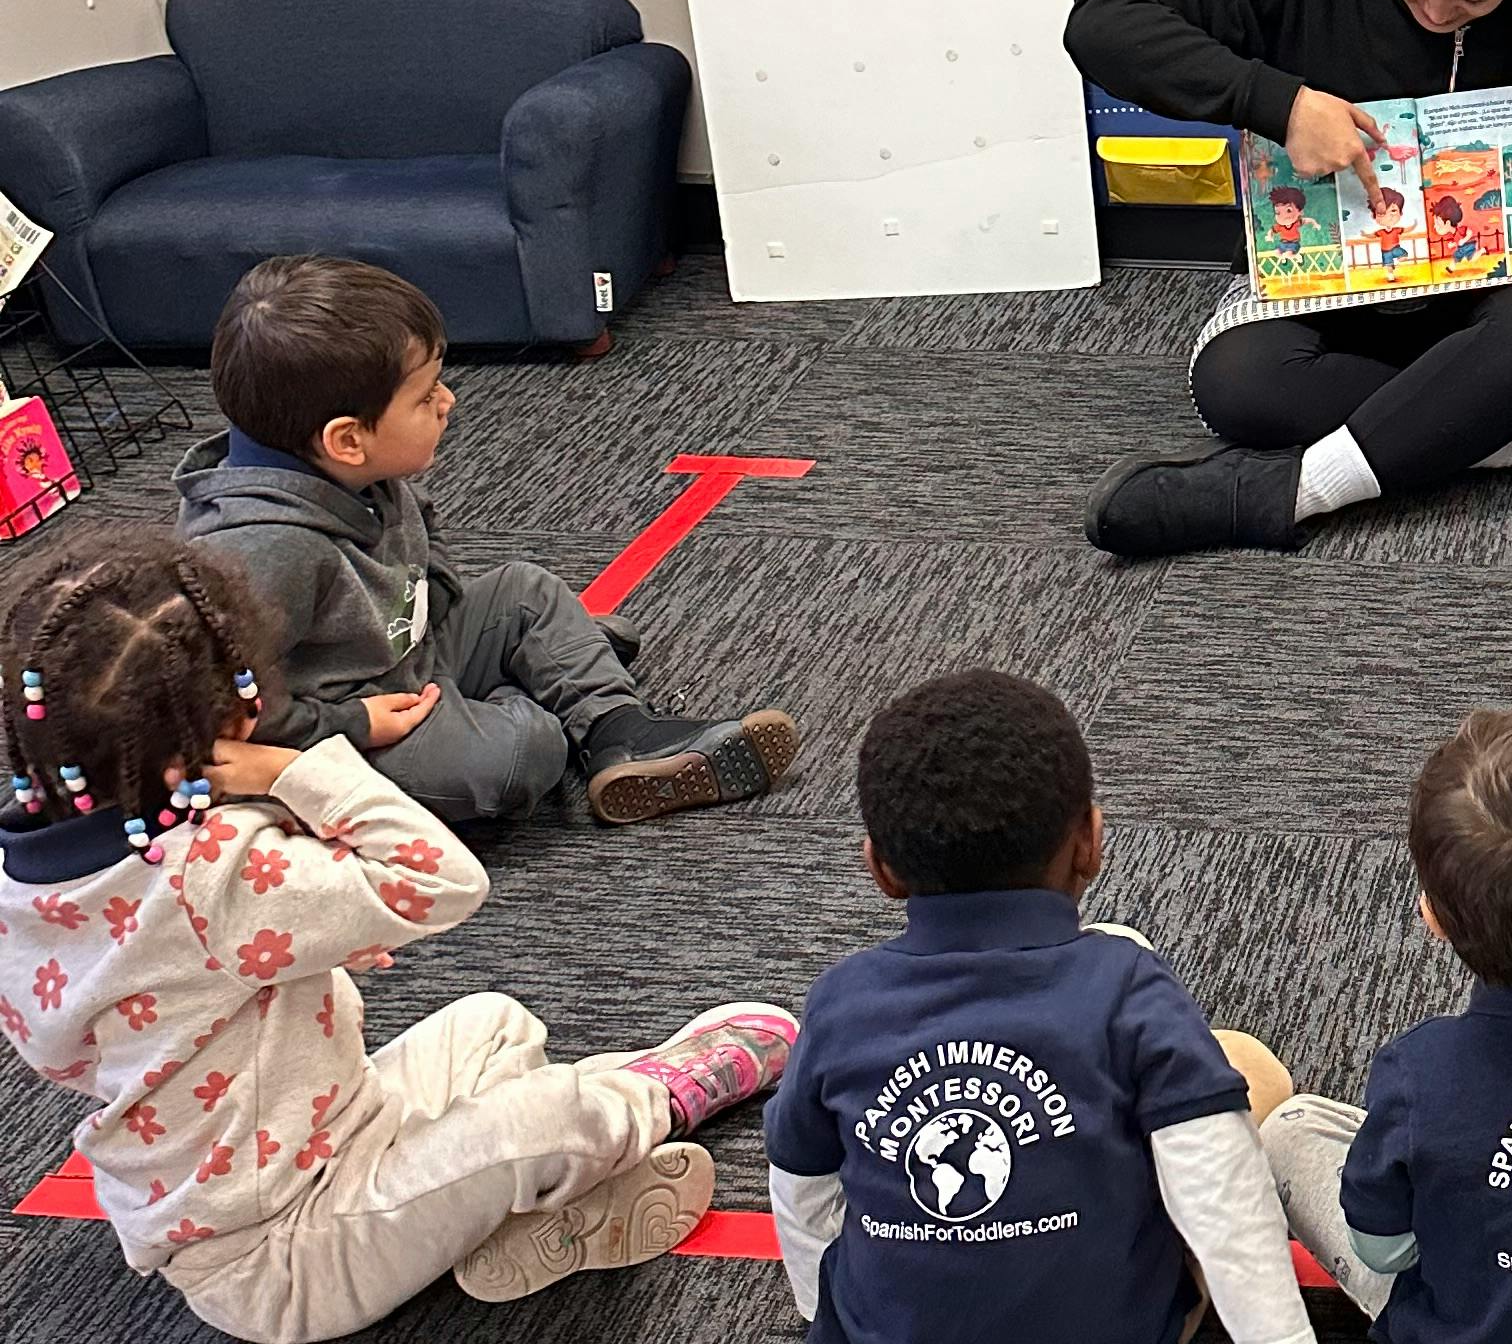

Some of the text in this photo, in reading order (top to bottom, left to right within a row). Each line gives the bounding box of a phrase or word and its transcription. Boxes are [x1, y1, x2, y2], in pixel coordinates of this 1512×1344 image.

[855, 1041, 1076, 1153] PANISH IMMERSION
[880, 1077, 1040, 1162] MONTESSORI
[861, 1211, 1078, 1242] SpanishForToddlers.com
